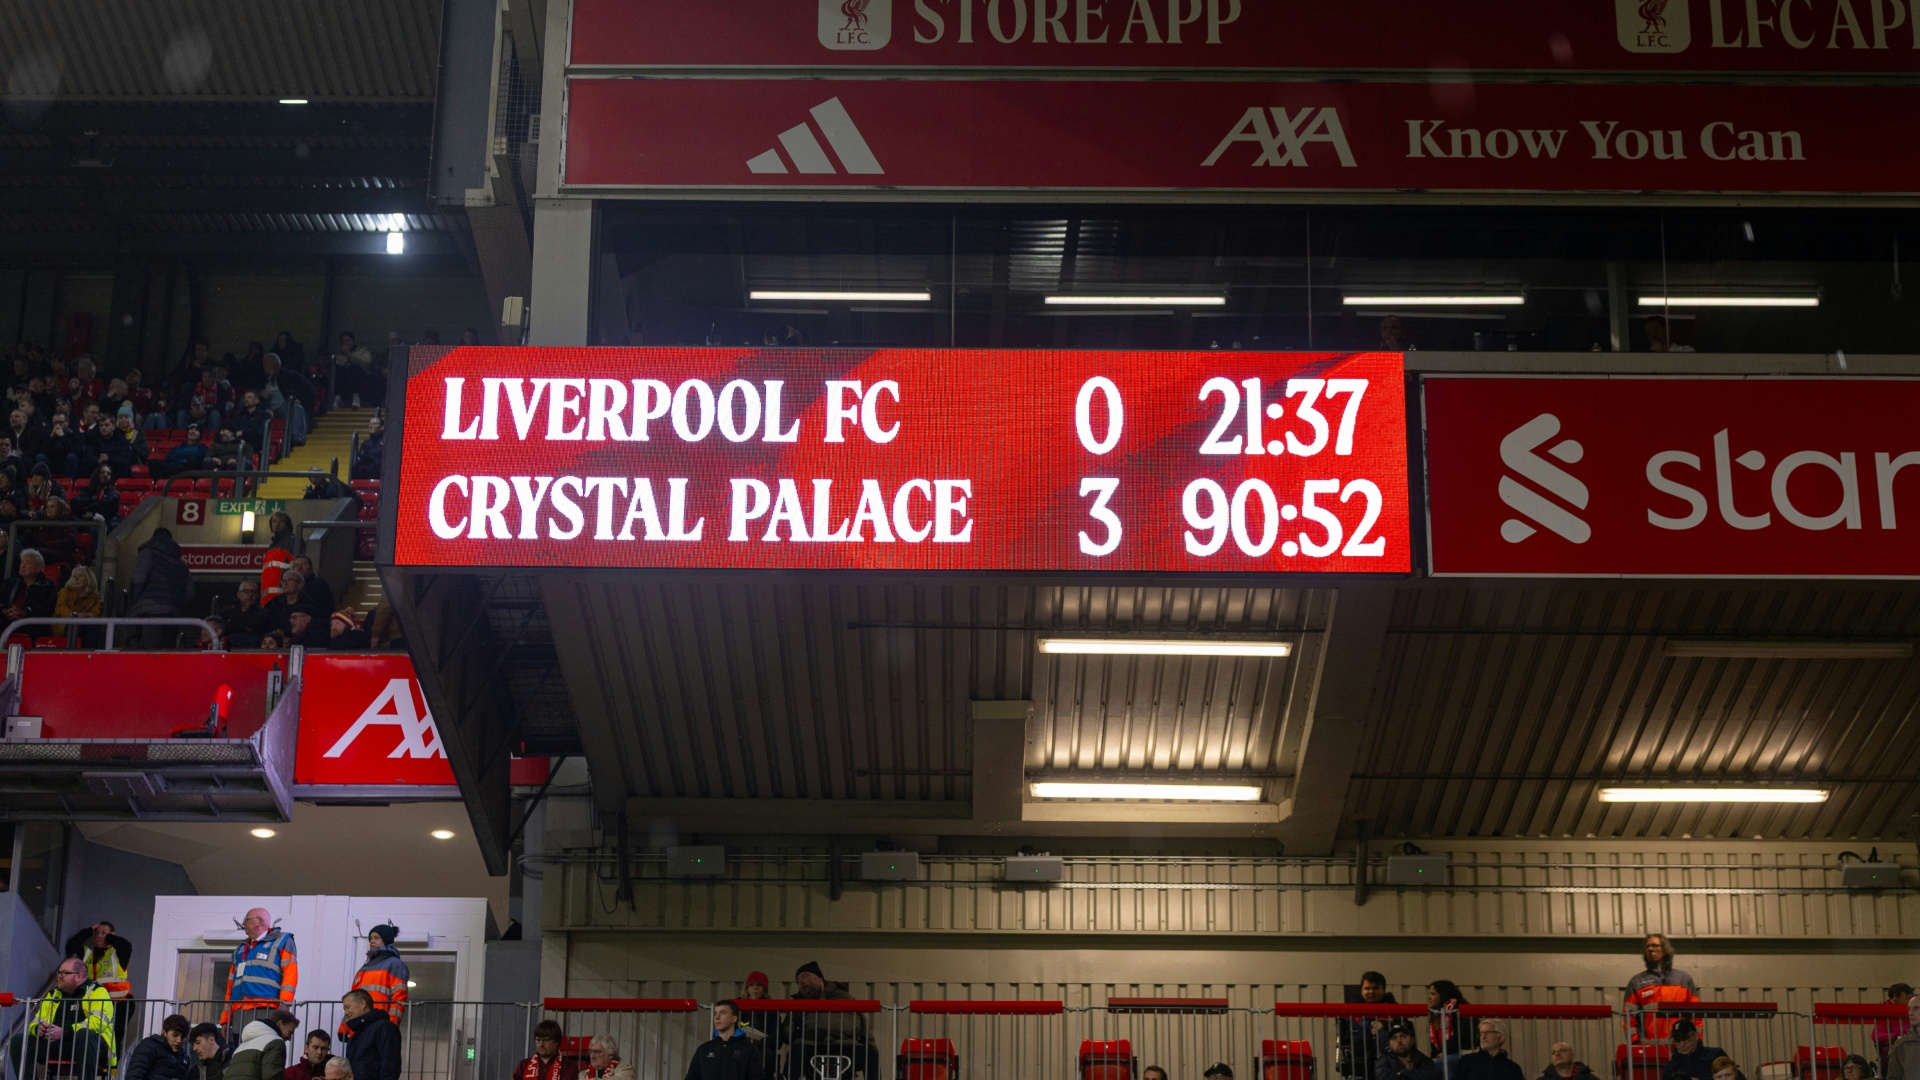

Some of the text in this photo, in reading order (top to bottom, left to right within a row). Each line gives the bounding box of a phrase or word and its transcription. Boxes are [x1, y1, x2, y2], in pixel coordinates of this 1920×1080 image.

[836, 31, 871, 44] L.F.C.
[1636, 35, 1672, 47] L.F.C.
[1826, 0, 1920, 50] AP
[1201, 107, 1807, 168] AXA Know You Can
[441, 376, 1370, 457] LIVERPOOL FC 0 21:37
[182, 502, 200, 523] 8
[220, 502, 250, 513] EXIT
[428, 475, 1387, 558] CRYSTAL PALACE 3 90:52
[181, 553, 251, 566] standard
[322, 678, 449, 759] AX
